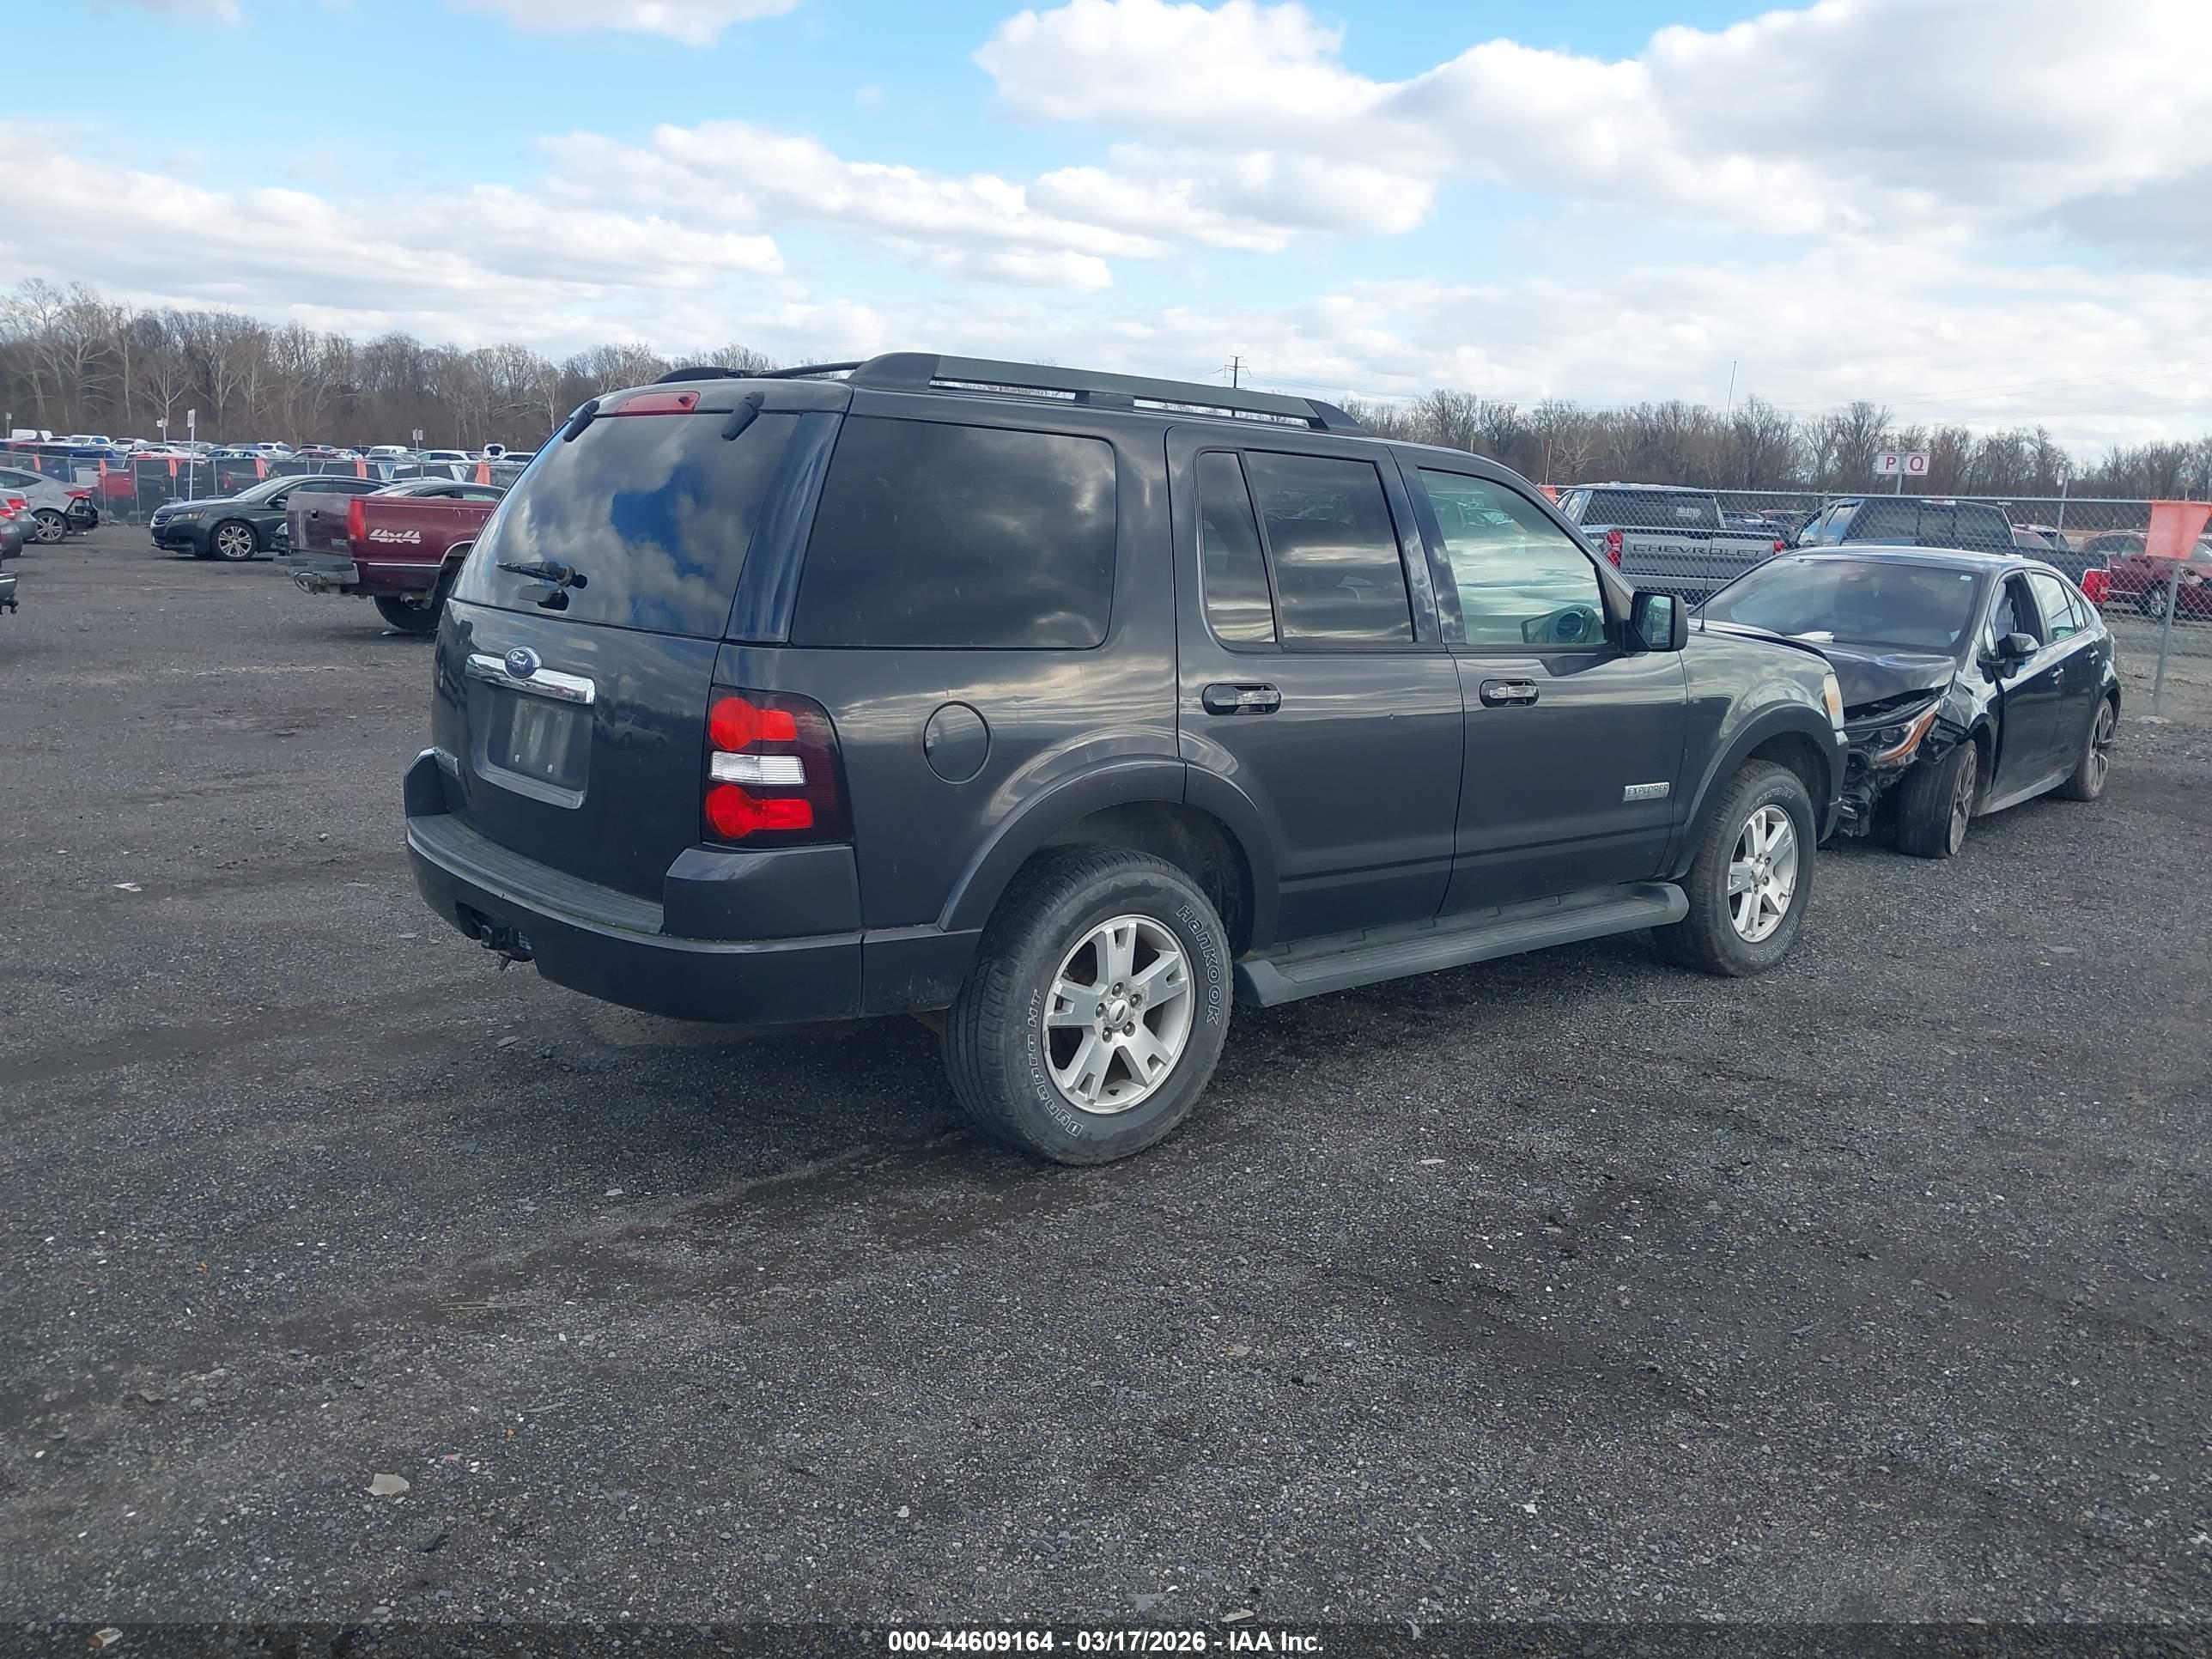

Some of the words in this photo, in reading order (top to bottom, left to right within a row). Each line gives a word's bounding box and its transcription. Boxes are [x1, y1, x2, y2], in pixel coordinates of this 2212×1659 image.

[1885, 456, 1897, 471] P
[1909, 455, 1924, 471] Q
[368, 529, 422, 544] 4x4
[1633, 544, 1765, 557] CHEVROLET
[1627, 783, 1668, 795] EXPLORER
[1025, 1036, 1084, 1138] Dynapro
